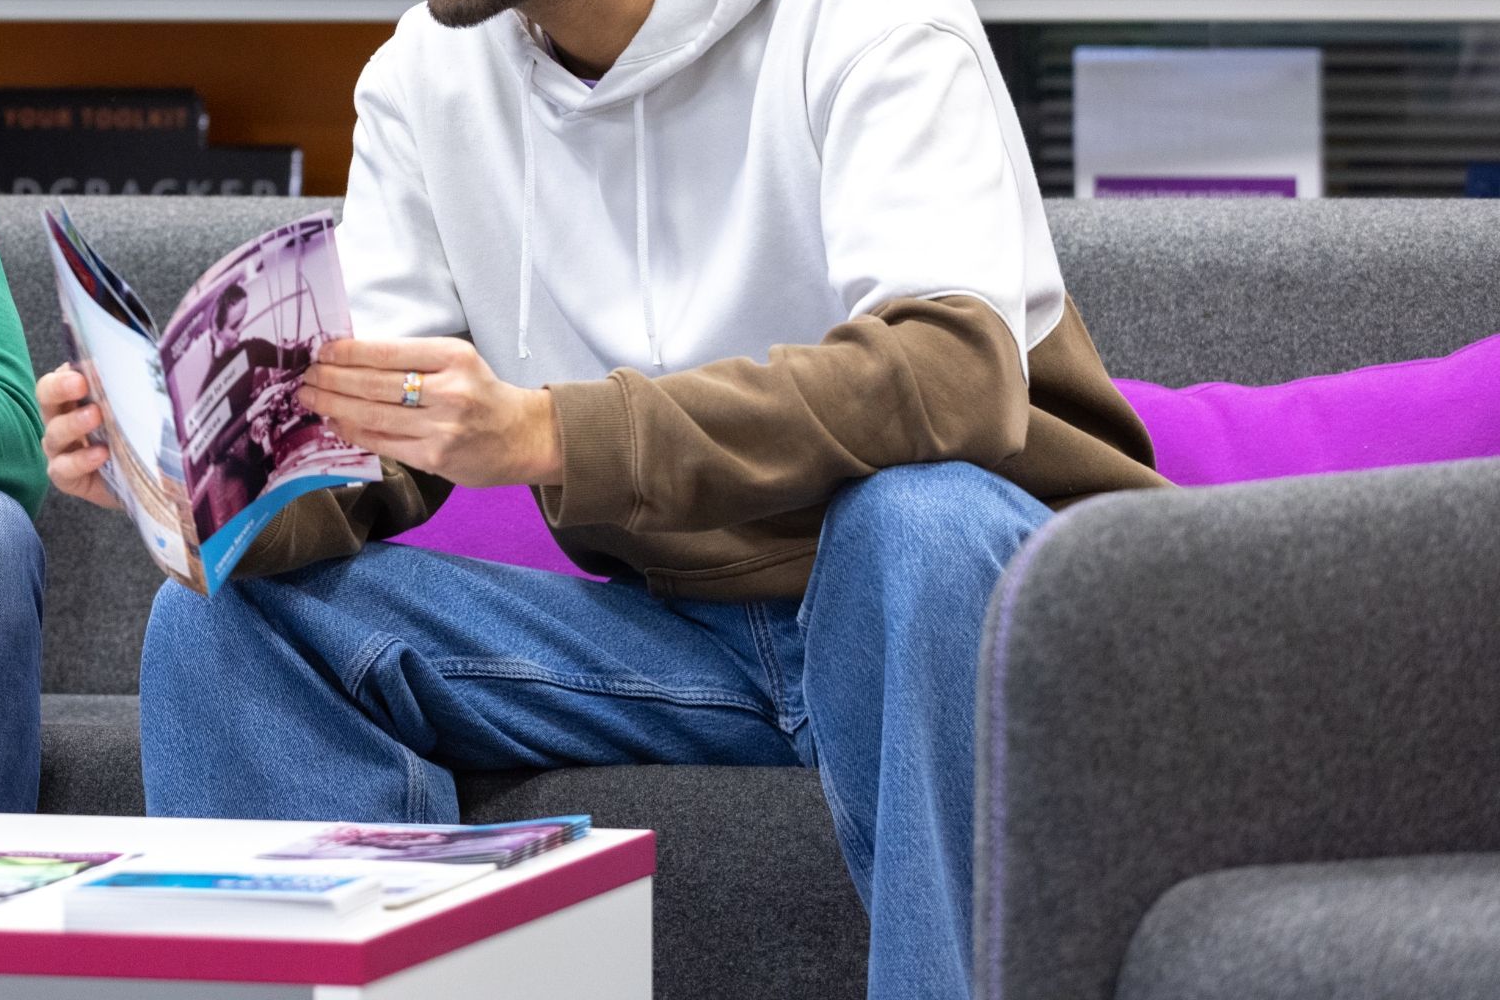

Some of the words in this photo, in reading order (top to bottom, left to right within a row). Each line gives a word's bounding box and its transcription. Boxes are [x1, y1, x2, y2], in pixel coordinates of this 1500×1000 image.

[4, 107, 73, 130] YOUR
[81, 107, 187, 130] TOOLKIT
[214, 542, 236, 574] Careers
[234, 518, 256, 546] Service
